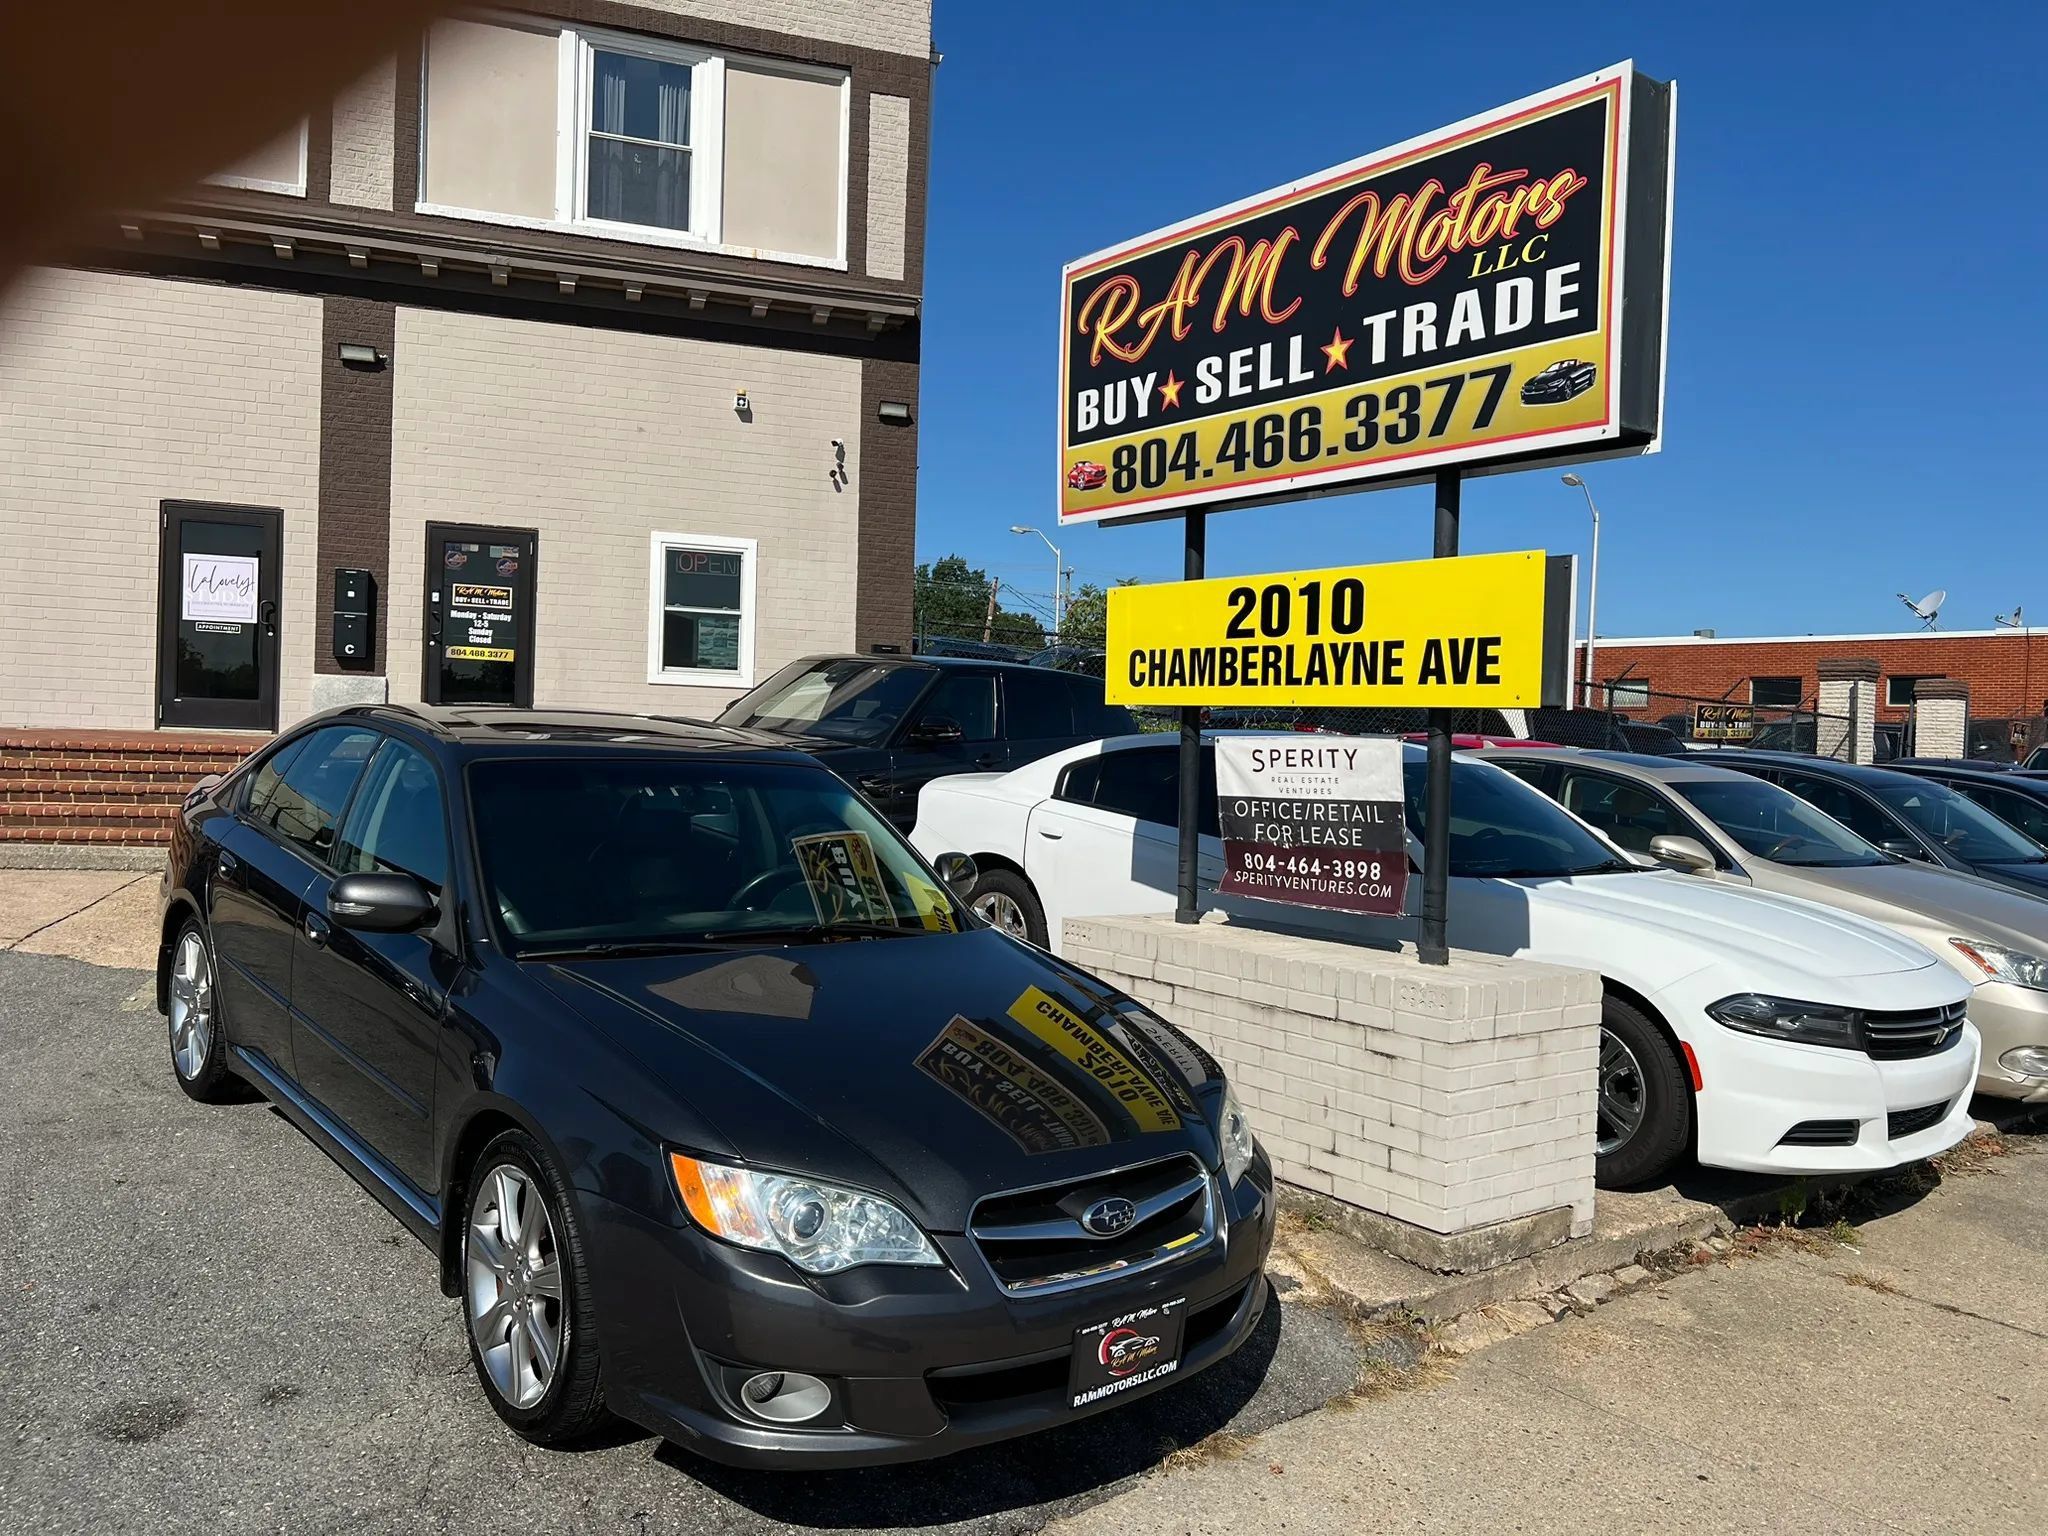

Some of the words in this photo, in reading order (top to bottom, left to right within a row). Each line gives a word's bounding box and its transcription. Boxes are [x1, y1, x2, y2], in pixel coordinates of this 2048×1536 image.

[1078, 225, 1302, 367] RAM
[1311, 162, 1587, 297] Motors
[1467, 233, 1549, 279] LLC
[1077, 371, 1157, 433] BUY
[1195, 334, 1314, 404] SELL
[1363, 262, 1580, 365] TRADE
[1112, 361, 1513, 494] 804.466.3377
[679, 553, 736, 574] OPEN
[490, 598, 509, 606] TRADE
[1225, 577, 1365, 639] 2010
[198, 624, 239, 632] APPOINTMENT
[450, 610, 477, 620] Monday
[482, 612, 512, 622] Saturday
[473, 620, 489, 628] 12-5
[468, 627, 493, 636] Sunday
[469, 635, 492, 644] Closed
[344, 644, 355, 655] C
[1128, 639, 1404, 688] CHAMBERLAYNE
[1418, 636, 1501, 686] AVE
[1252, 748, 1358, 773] SPERITY
[1271, 776, 1295, 784] REAL
[1301, 776, 1340, 785] ESTATE
[1278, 787, 1332, 795] VENTURES
[1234, 800, 1384, 824] OFFICE/RETAIL
[1255, 823, 1293, 843] FOR
[1300, 825, 1363, 847] LEASE
[1244, 852, 1382, 881] 804-464-3898
[1234, 870, 1393, 898] SPERITYVENTURES.COM
[1073, 1360, 1178, 1407] RAMMOTORSLLC.COM
